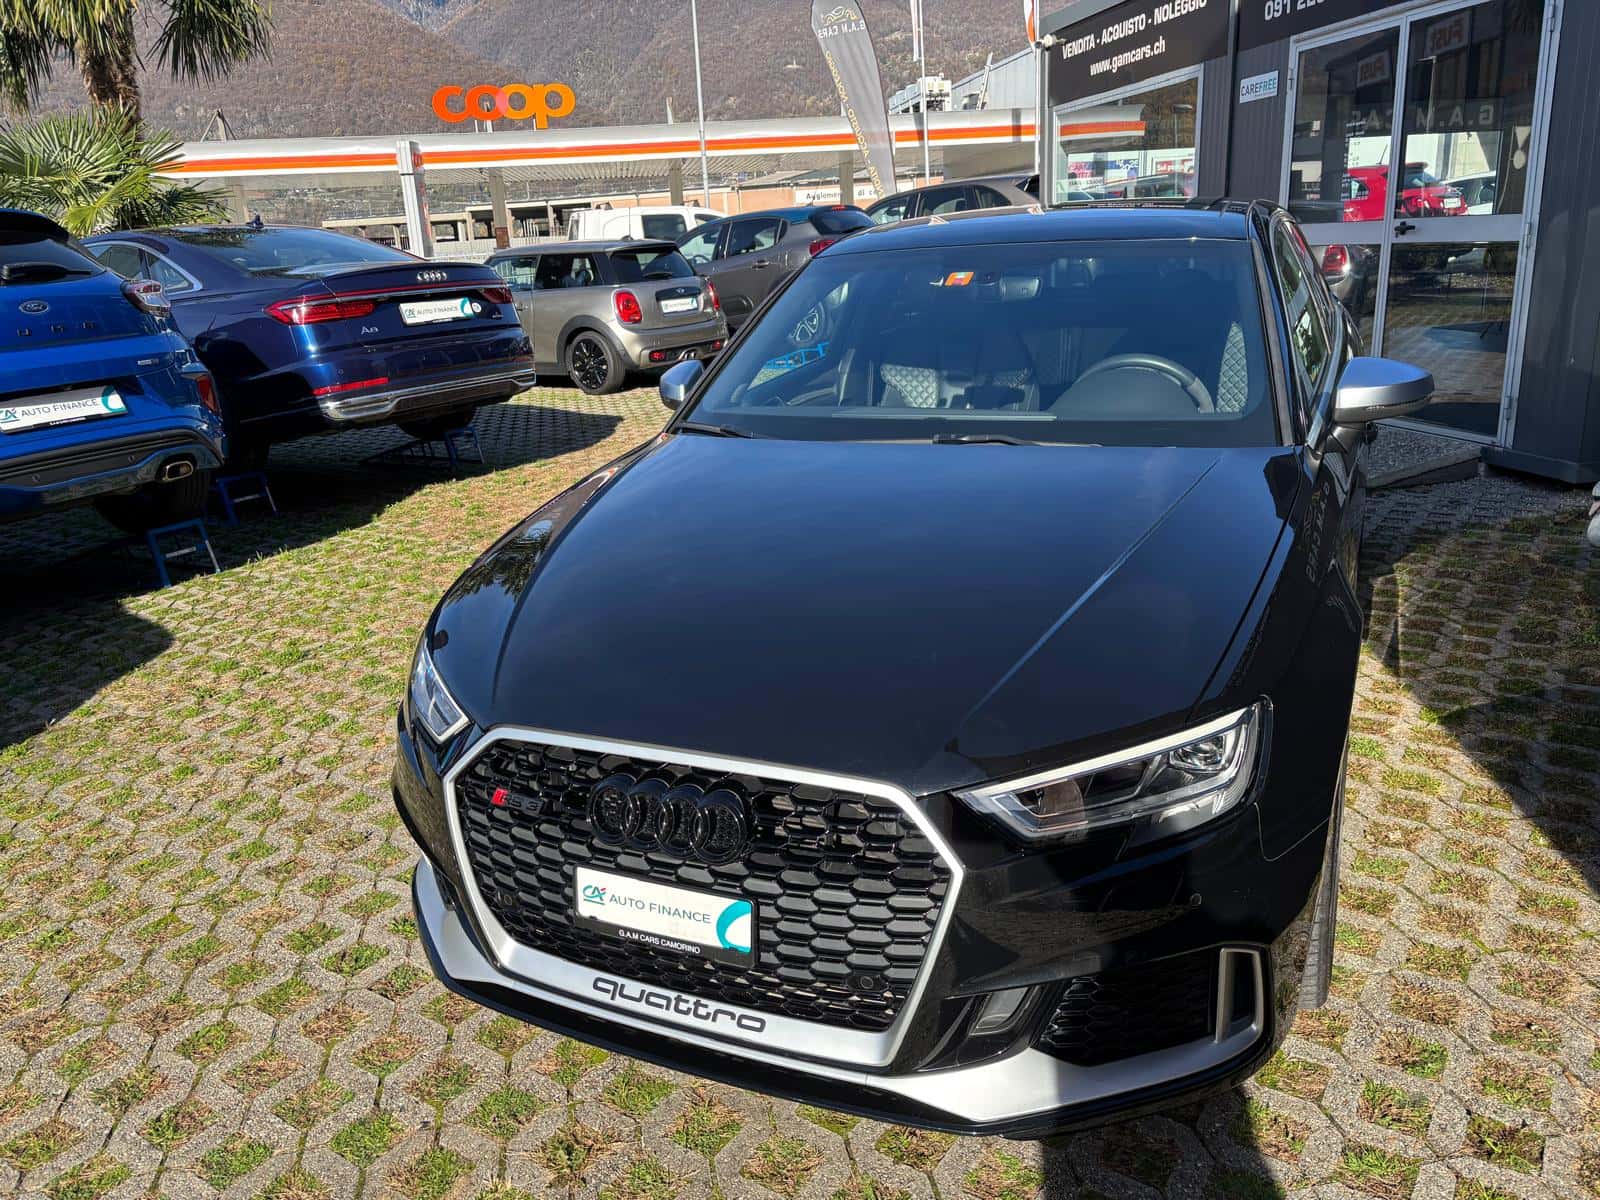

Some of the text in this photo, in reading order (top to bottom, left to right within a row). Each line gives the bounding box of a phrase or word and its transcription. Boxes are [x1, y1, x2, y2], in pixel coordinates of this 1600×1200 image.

[1062, 33, 1096, 59] VENDITA
[1101, 13, 1146, 45] ACQUISTO
[1090, 35, 1167, 76] www.gamcars.ch
[1240, 78, 1277, 97] CAREFREE
[432, 82, 576, 129] coop
[21, 405, 51, 418] AUTO
[54, 398, 98, 412] FINANCE
[609, 894, 646, 910] AUTO
[649, 903, 712, 924] FINANCE
[639, 934, 660, 945] CARS
[660, 939, 701, 954] CAMORINO
[592, 976, 767, 1033] quattro
